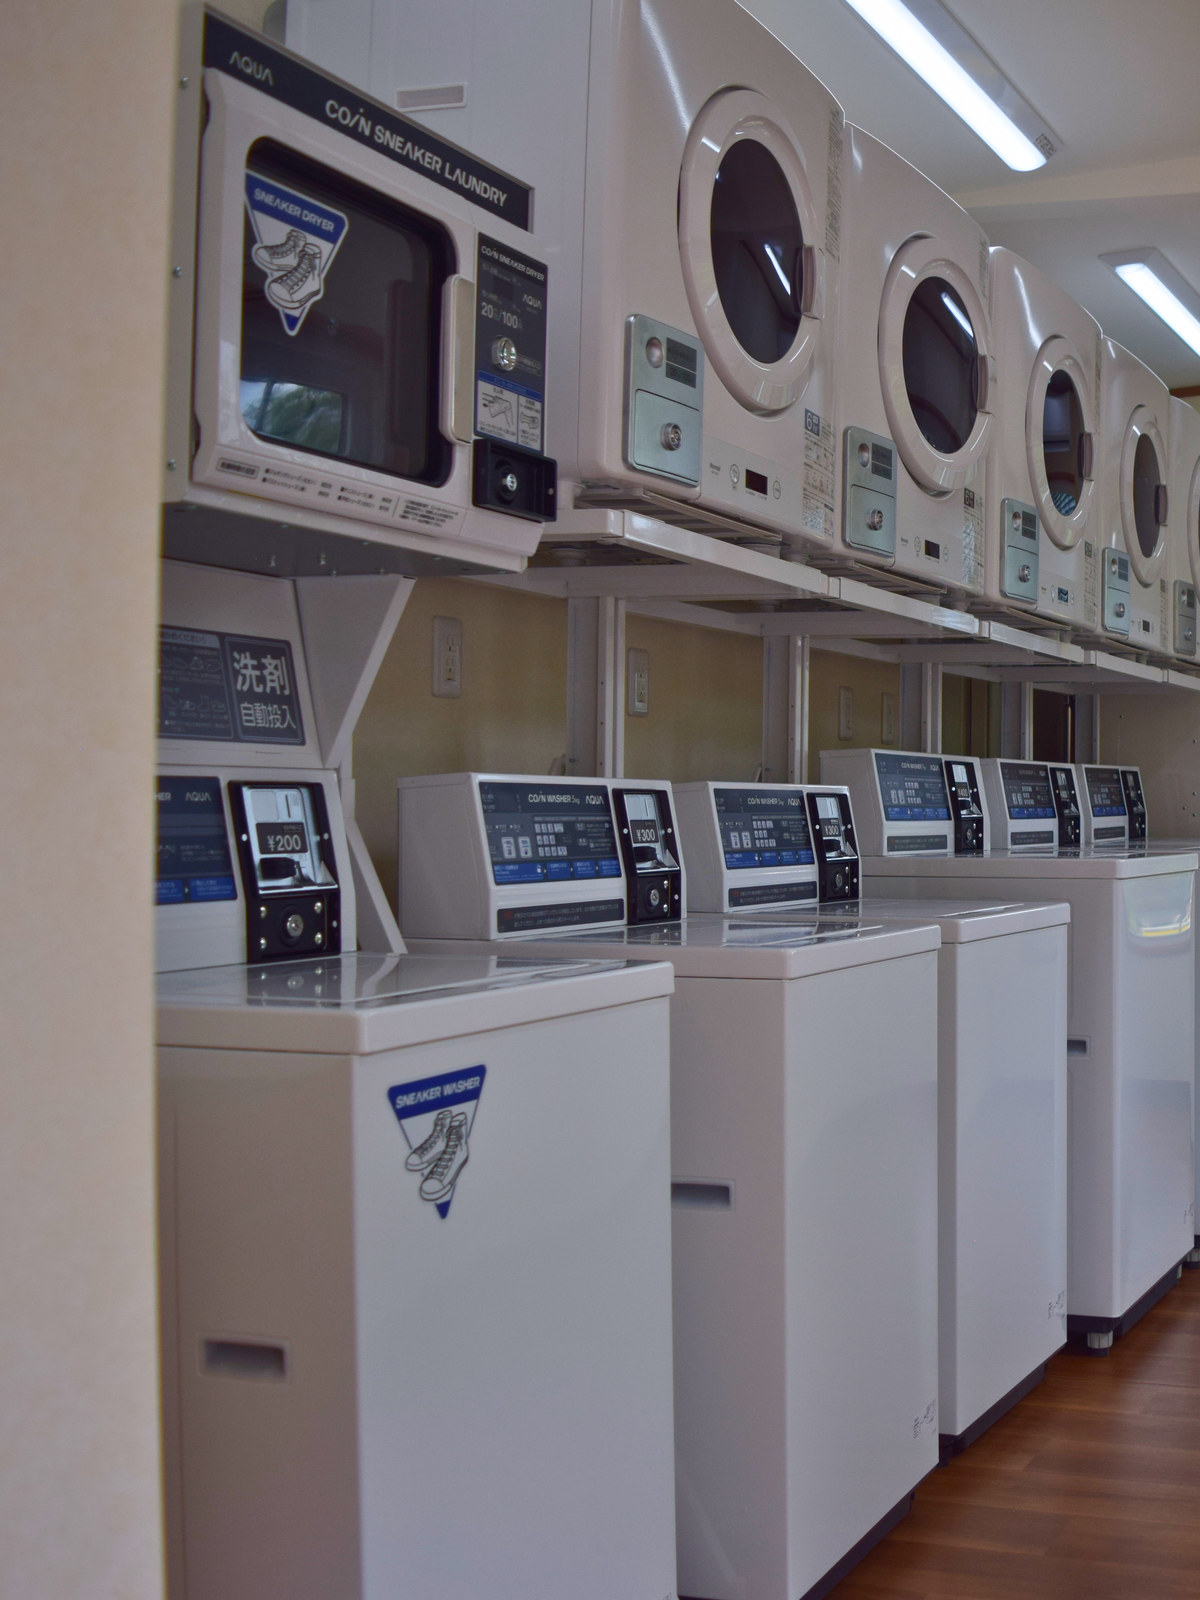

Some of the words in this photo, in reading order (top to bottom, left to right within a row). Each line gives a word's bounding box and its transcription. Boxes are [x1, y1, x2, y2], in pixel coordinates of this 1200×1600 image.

[230, 51, 275, 86] AQUA
[373, 125, 443, 174] SNEAKER
[444, 162, 508, 208] LAUNDRY
[253, 187, 301, 219] SNEAKER
[301, 206, 336, 234] DRYER
[498, 253, 526, 273] SNEAKER
[526, 265, 545, 281] DRYER
[481, 301, 494, 319] 20
[522, 294, 543, 310] AQUA
[232, 651, 290, 696] 洗剤
[240, 701, 297, 729] 自動投入
[185, 792, 212, 802] AQUA
[546, 794, 571, 804] WASHER
[585, 795, 605, 805] AQUA
[266, 834, 302, 852] ¥200
[636, 828, 656, 842] ¥300
[395, 1086, 442, 1110] SNEAKER
[442, 1076, 481, 1097] WASHER
